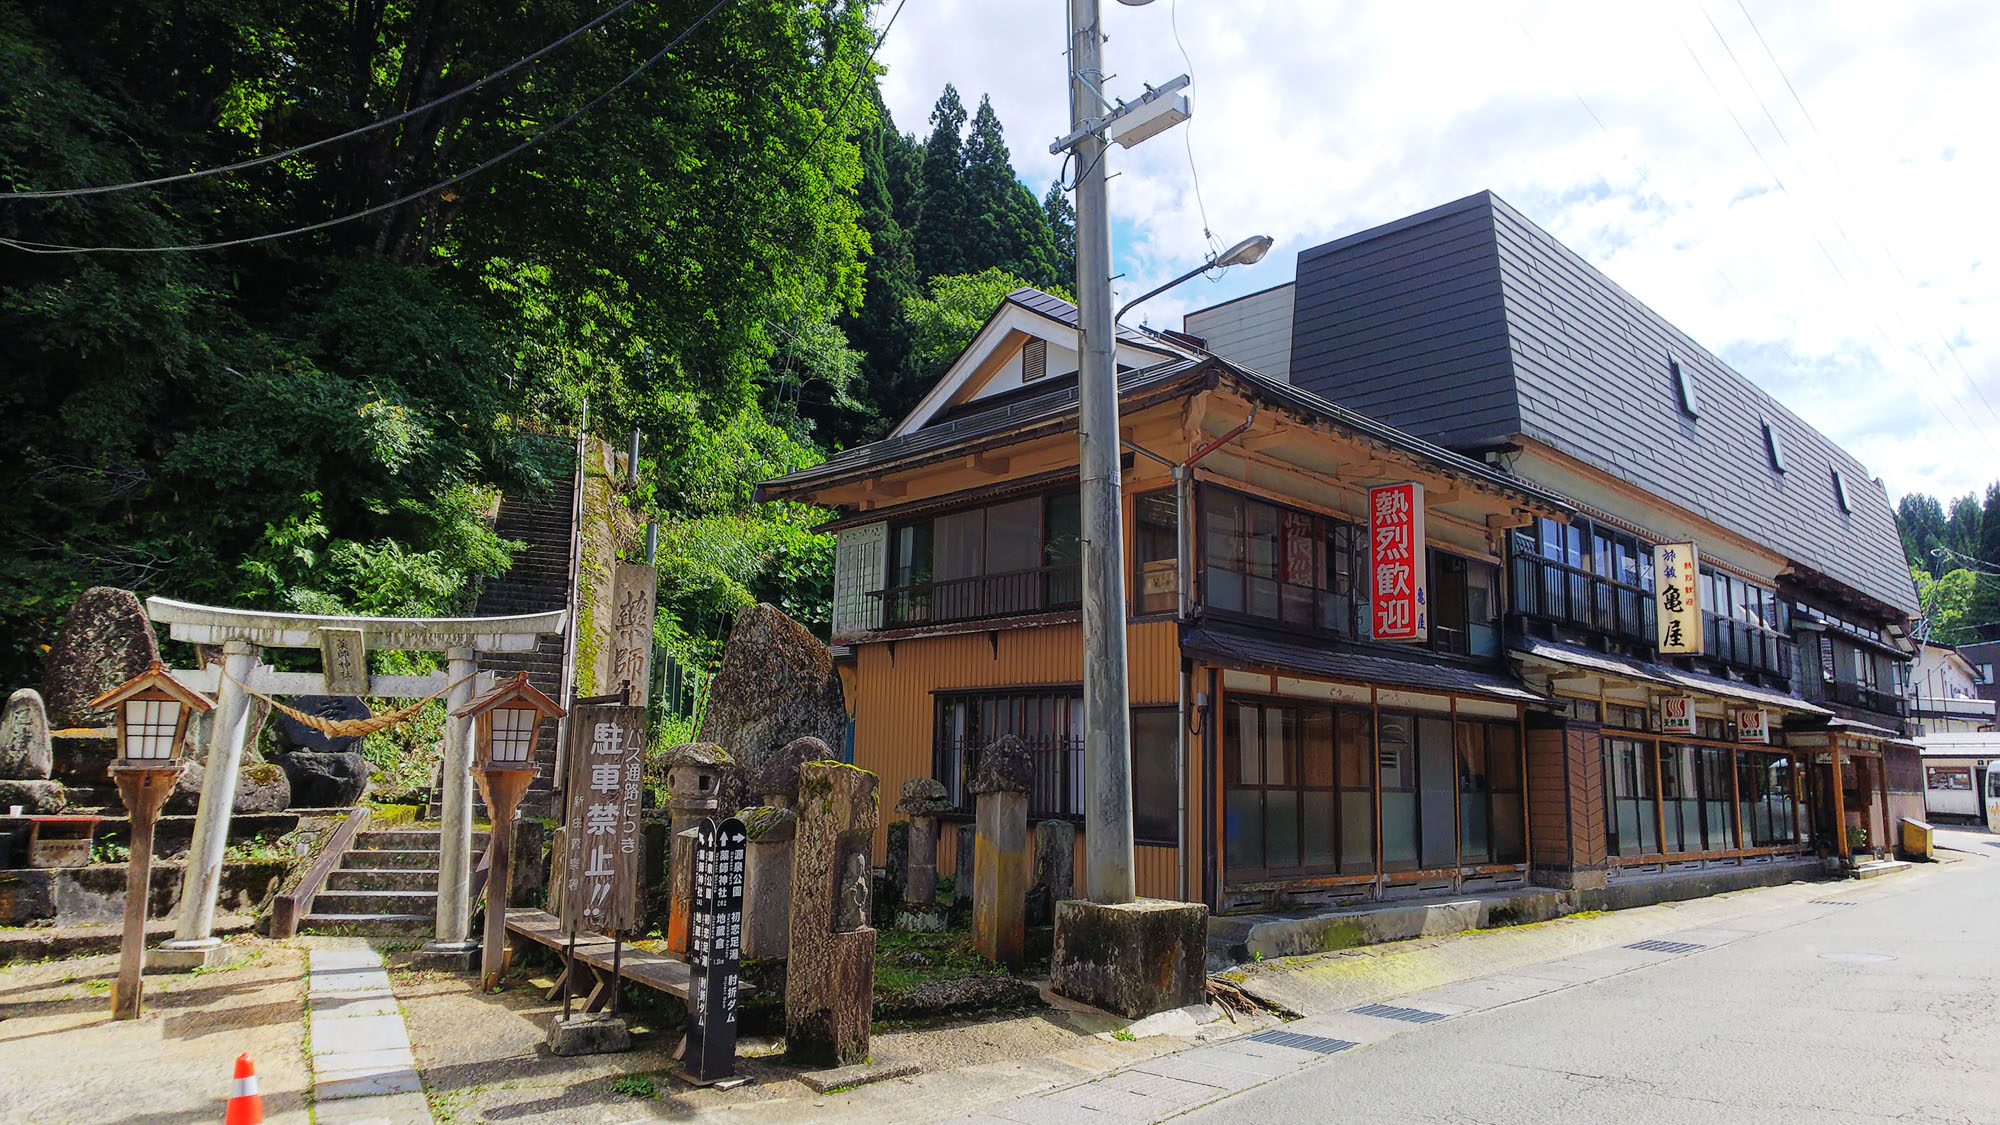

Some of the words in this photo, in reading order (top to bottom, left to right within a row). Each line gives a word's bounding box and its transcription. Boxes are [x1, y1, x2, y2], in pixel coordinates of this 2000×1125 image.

[1375, 489, 1411, 635] 熱烈歓迎
[1417, 586, 1426, 630] 亀屋
[1662, 583, 1685, 647] 亀屋
[337, 638, 353, 681] 薬師神社
[1663, 718, 1690, 727] 天然温泉
[621, 727, 644, 854] バス通路につき
[583, 722, 624, 916] 駐車禁止!!
[718, 849, 730, 899] 薬師神社
[732, 849, 744, 897] 源泉公園
[715, 913, 726, 950] 地蔵倉
[729, 911, 741, 960] 初恋足湯
[726, 974, 738, 1024] 肘折ダム
